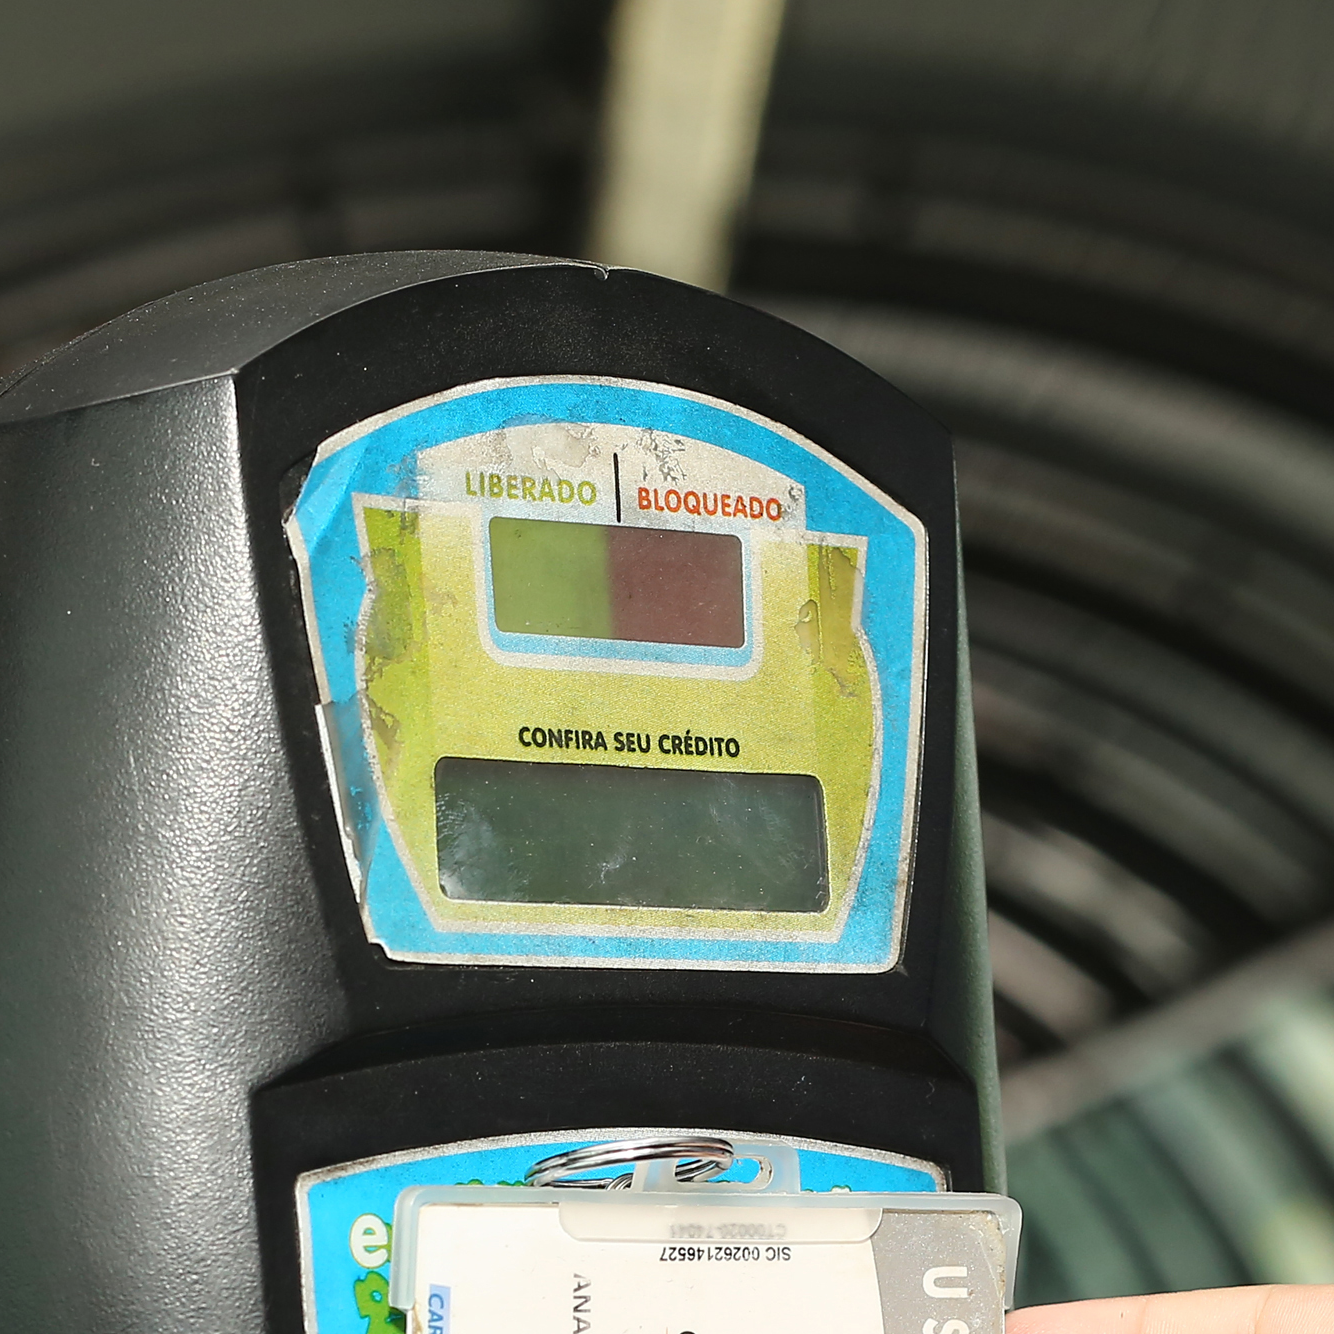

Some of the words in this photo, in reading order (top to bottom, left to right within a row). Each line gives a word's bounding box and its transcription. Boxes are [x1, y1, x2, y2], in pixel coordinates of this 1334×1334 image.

[465, 471, 597, 505] LIBERADO
[637, 486, 782, 521] BLOQUEADO
[518, 726, 608, 751] CONFIRA
[614, 731, 651, 753] SEU
[658, 729, 741, 757] CRÉDITO
[659, 1246, 761, 1262] 00262146527
[765, 1246, 792, 1262] SIC
